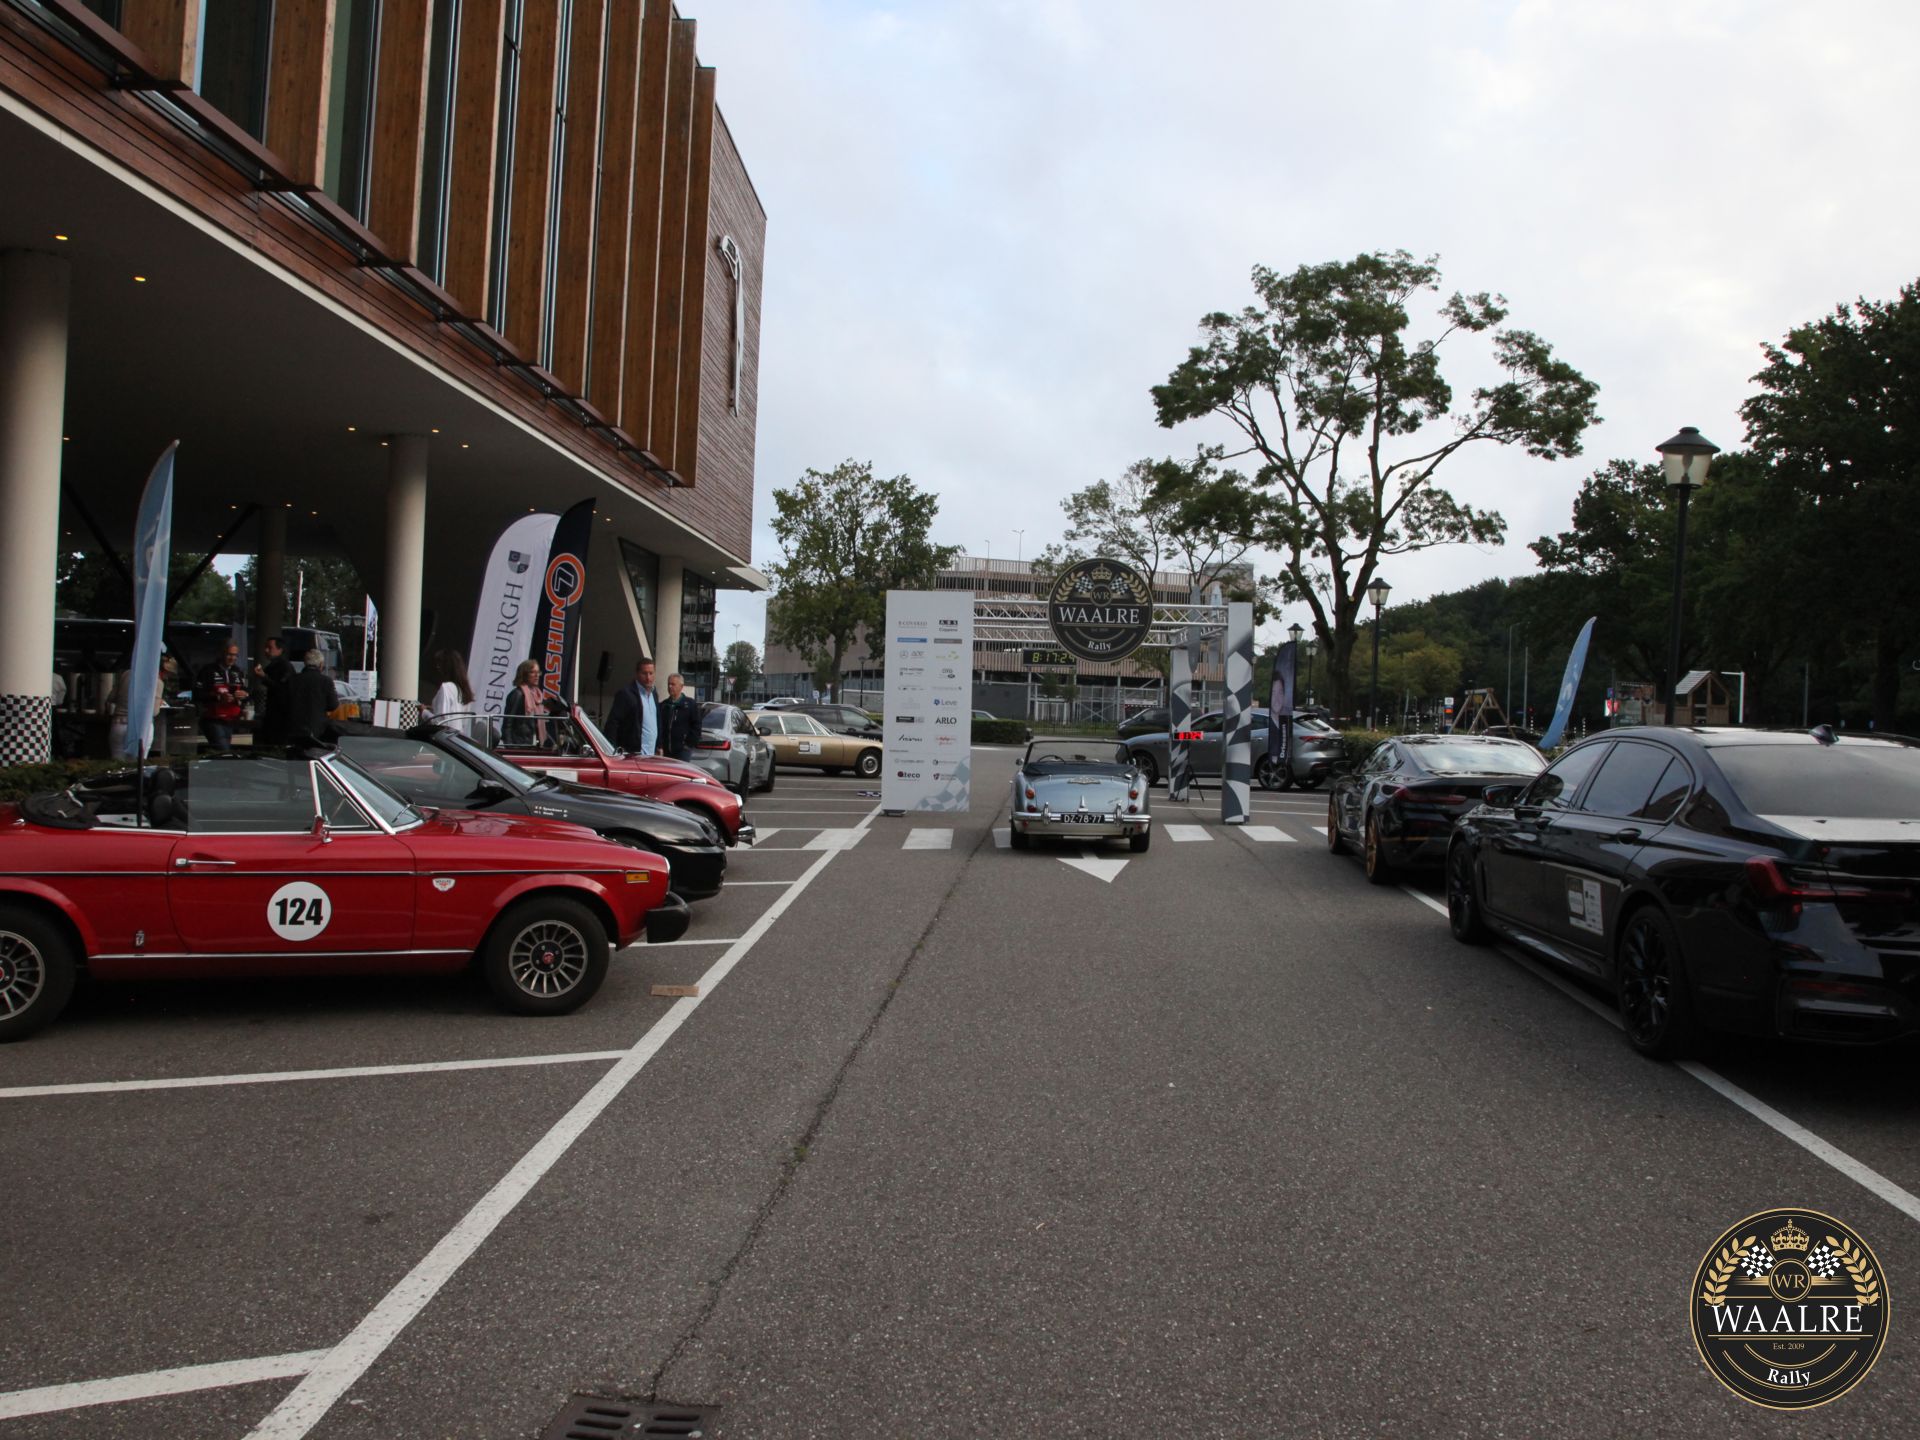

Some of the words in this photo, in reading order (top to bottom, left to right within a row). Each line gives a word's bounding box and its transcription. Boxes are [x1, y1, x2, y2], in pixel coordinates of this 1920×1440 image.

[1093, 591, 1110, 600] WR
[1059, 606, 1140, 624] WAALRE
[1088, 640, 1112, 652] Rally
[935, 716, 957, 725] ARLO
[275, 897, 324, 926] 124
